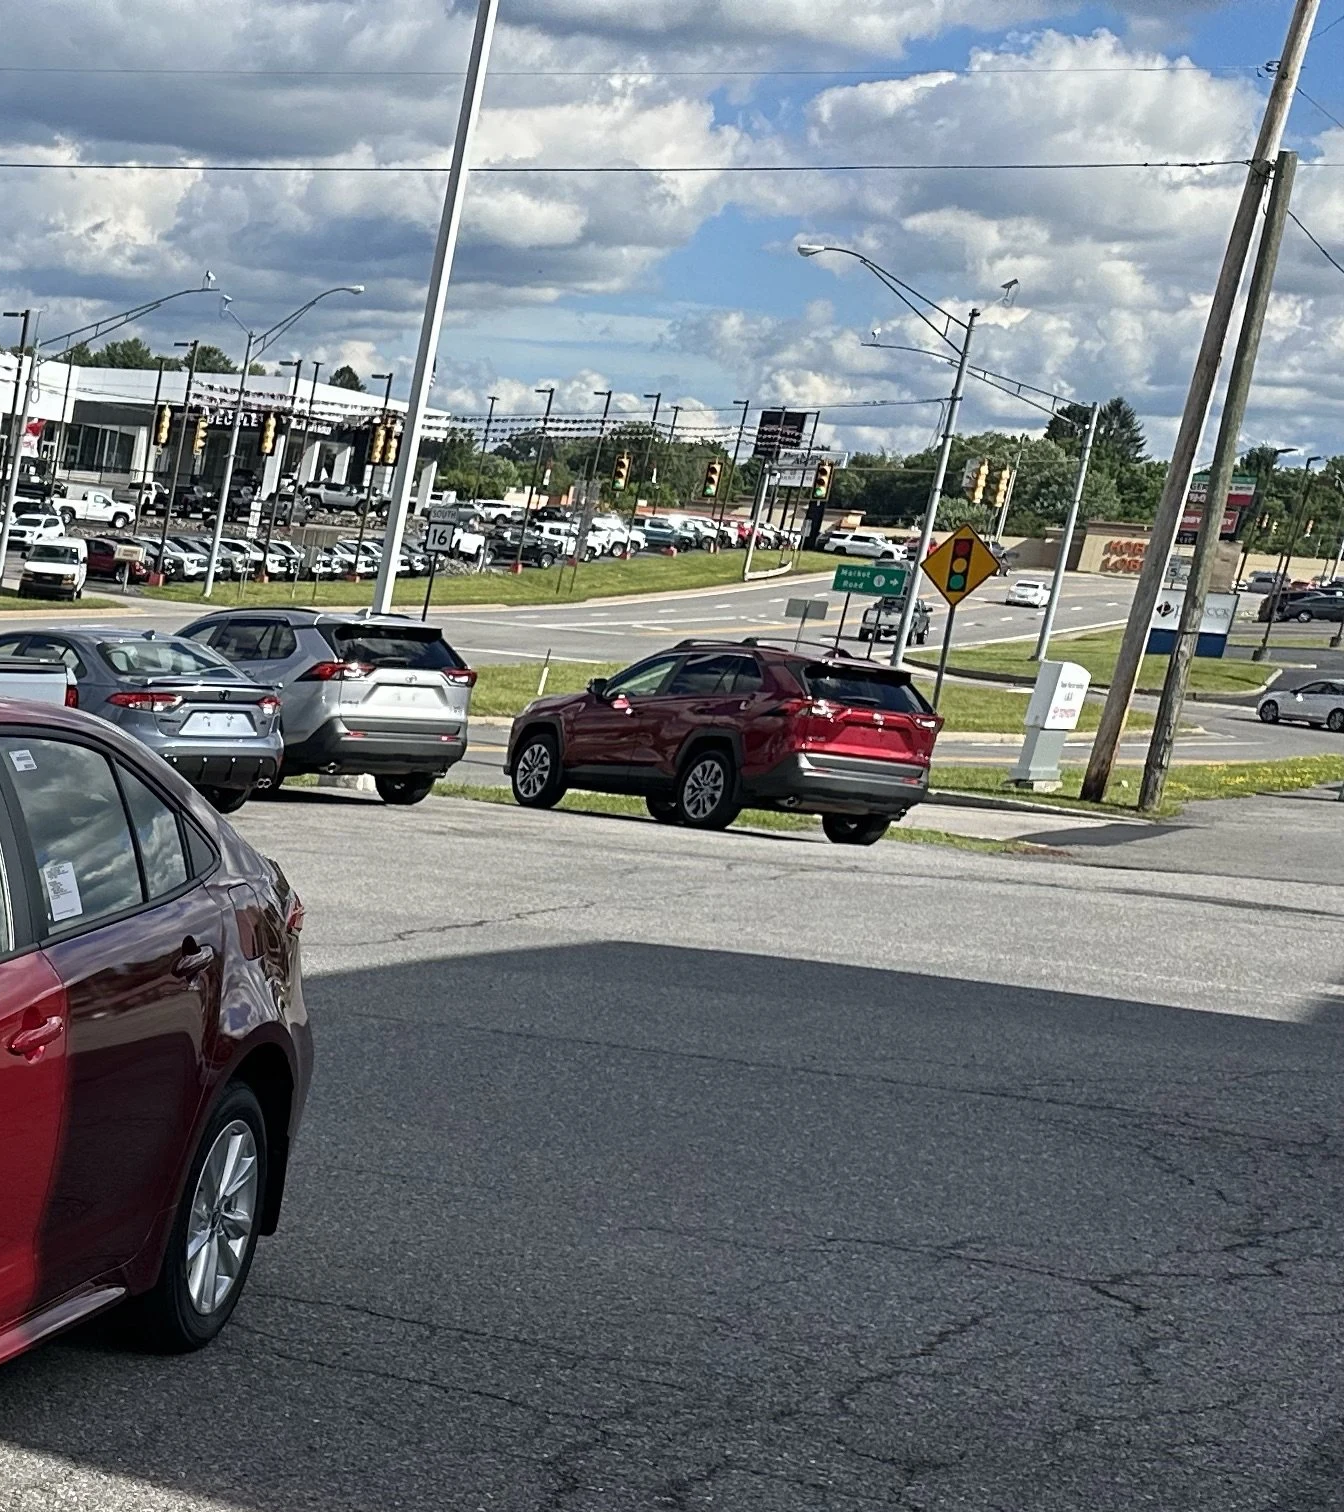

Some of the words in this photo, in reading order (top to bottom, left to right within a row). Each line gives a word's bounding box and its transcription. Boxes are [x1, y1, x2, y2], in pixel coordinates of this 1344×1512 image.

[431, 507, 457, 522] SOUTH
[431, 528, 448, 547] 16
[840, 568, 871, 579] Market
[842, 580, 864, 590] Road
